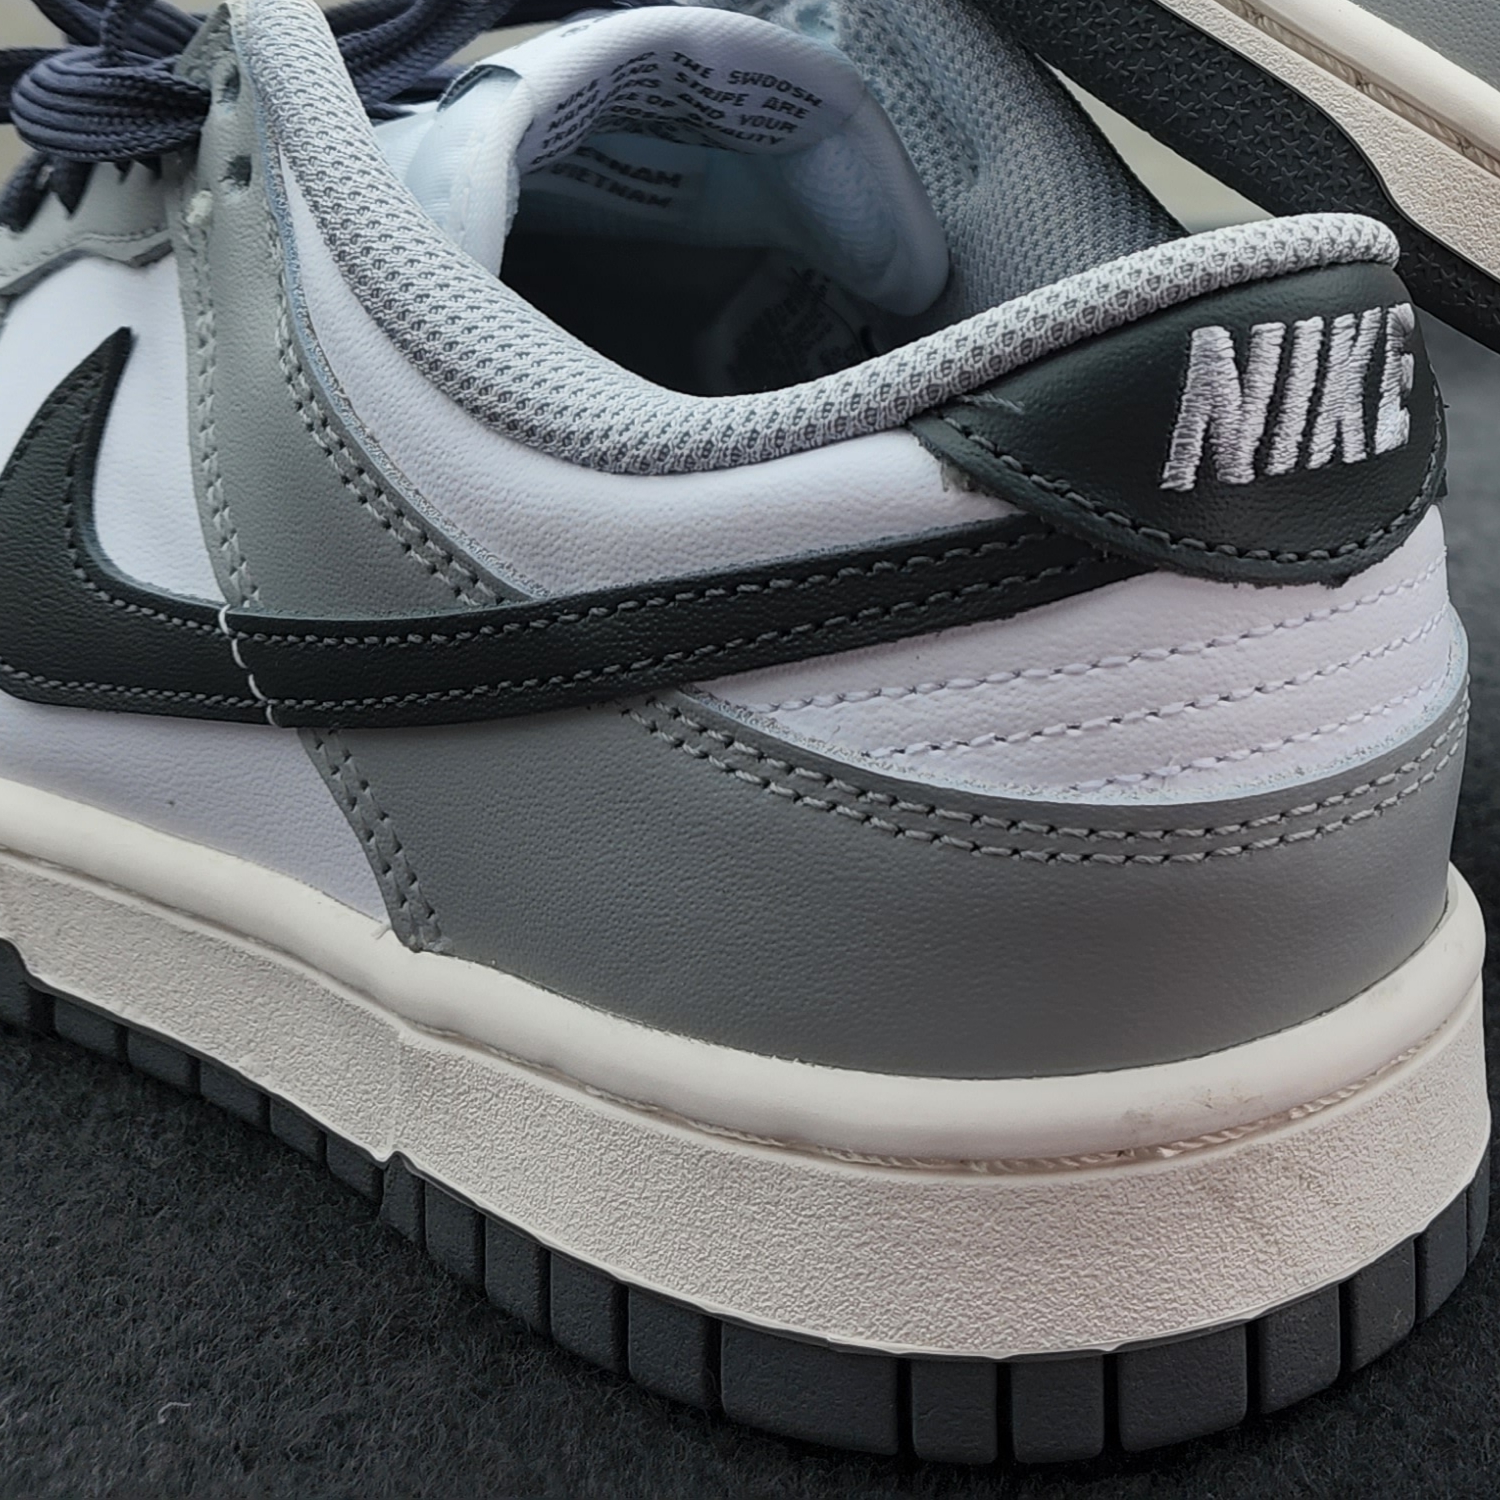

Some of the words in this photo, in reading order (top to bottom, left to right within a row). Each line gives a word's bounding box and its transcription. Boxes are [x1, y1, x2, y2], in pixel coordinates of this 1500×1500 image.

[671, 51, 714, 79] THE
[728, 70, 823, 108] SWOOSH
[674, 71, 749, 107] STRIPE
[761, 96, 810, 120] ARE
[677, 93, 725, 120] AND
[739, 114, 798, 134] YOUR
[688, 112, 784, 146] QUALITY
[1159, 302, 1415, 492] NIKE
